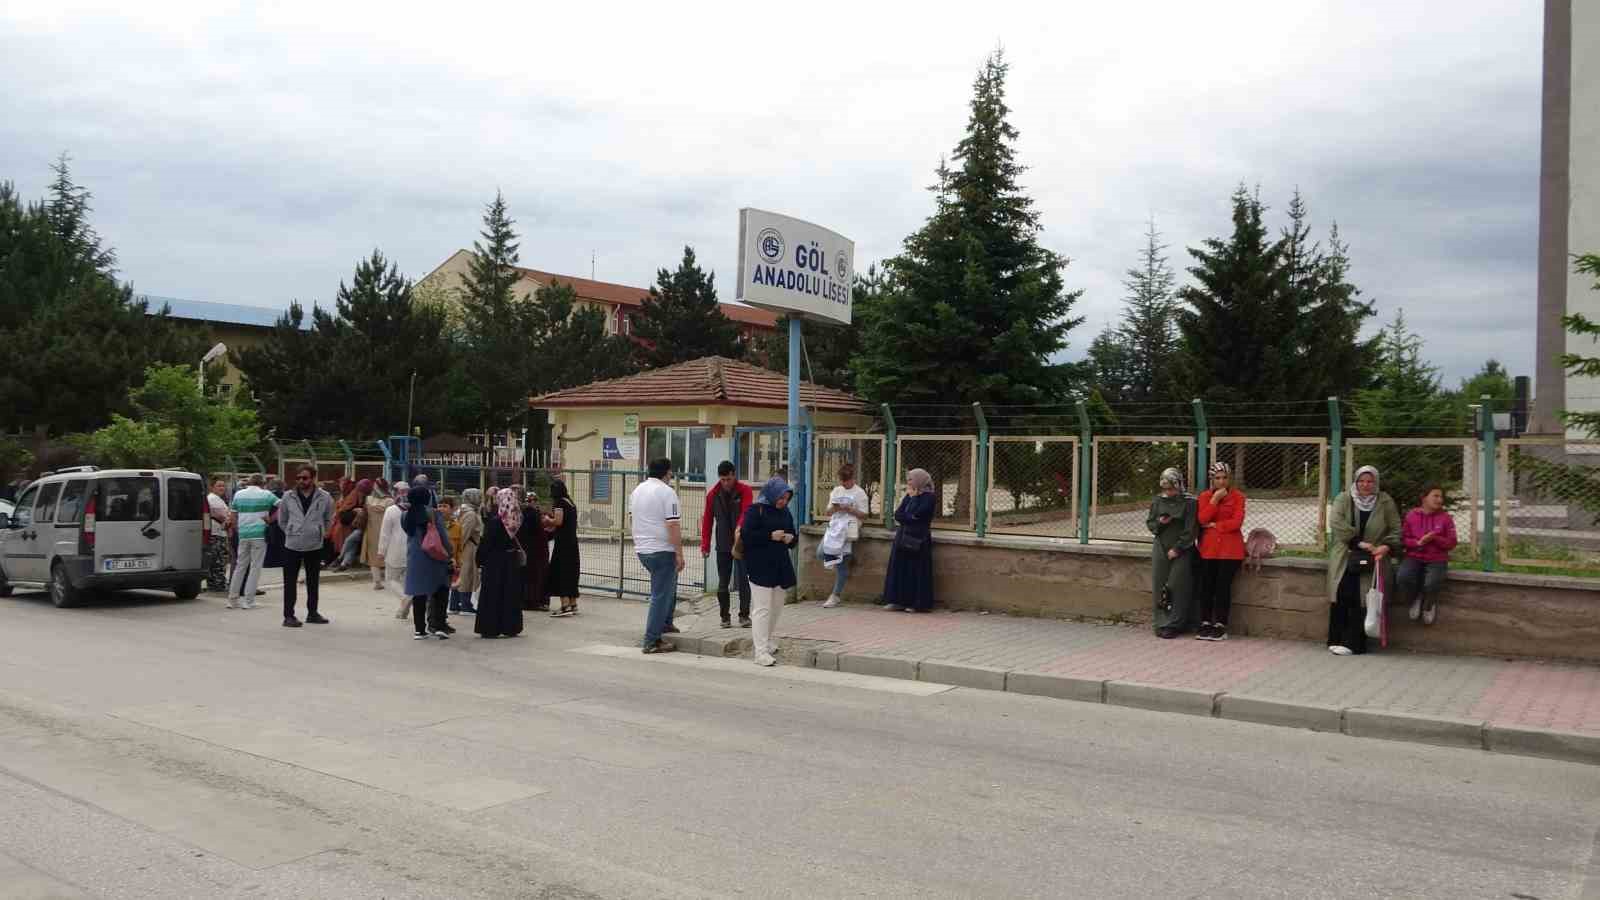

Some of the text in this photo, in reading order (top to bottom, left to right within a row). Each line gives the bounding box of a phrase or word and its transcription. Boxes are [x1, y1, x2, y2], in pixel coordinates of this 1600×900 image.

[796, 241, 829, 275] GÖL
[752, 264, 820, 296] ANADOLU
[822, 276, 849, 305] LİSESİ
